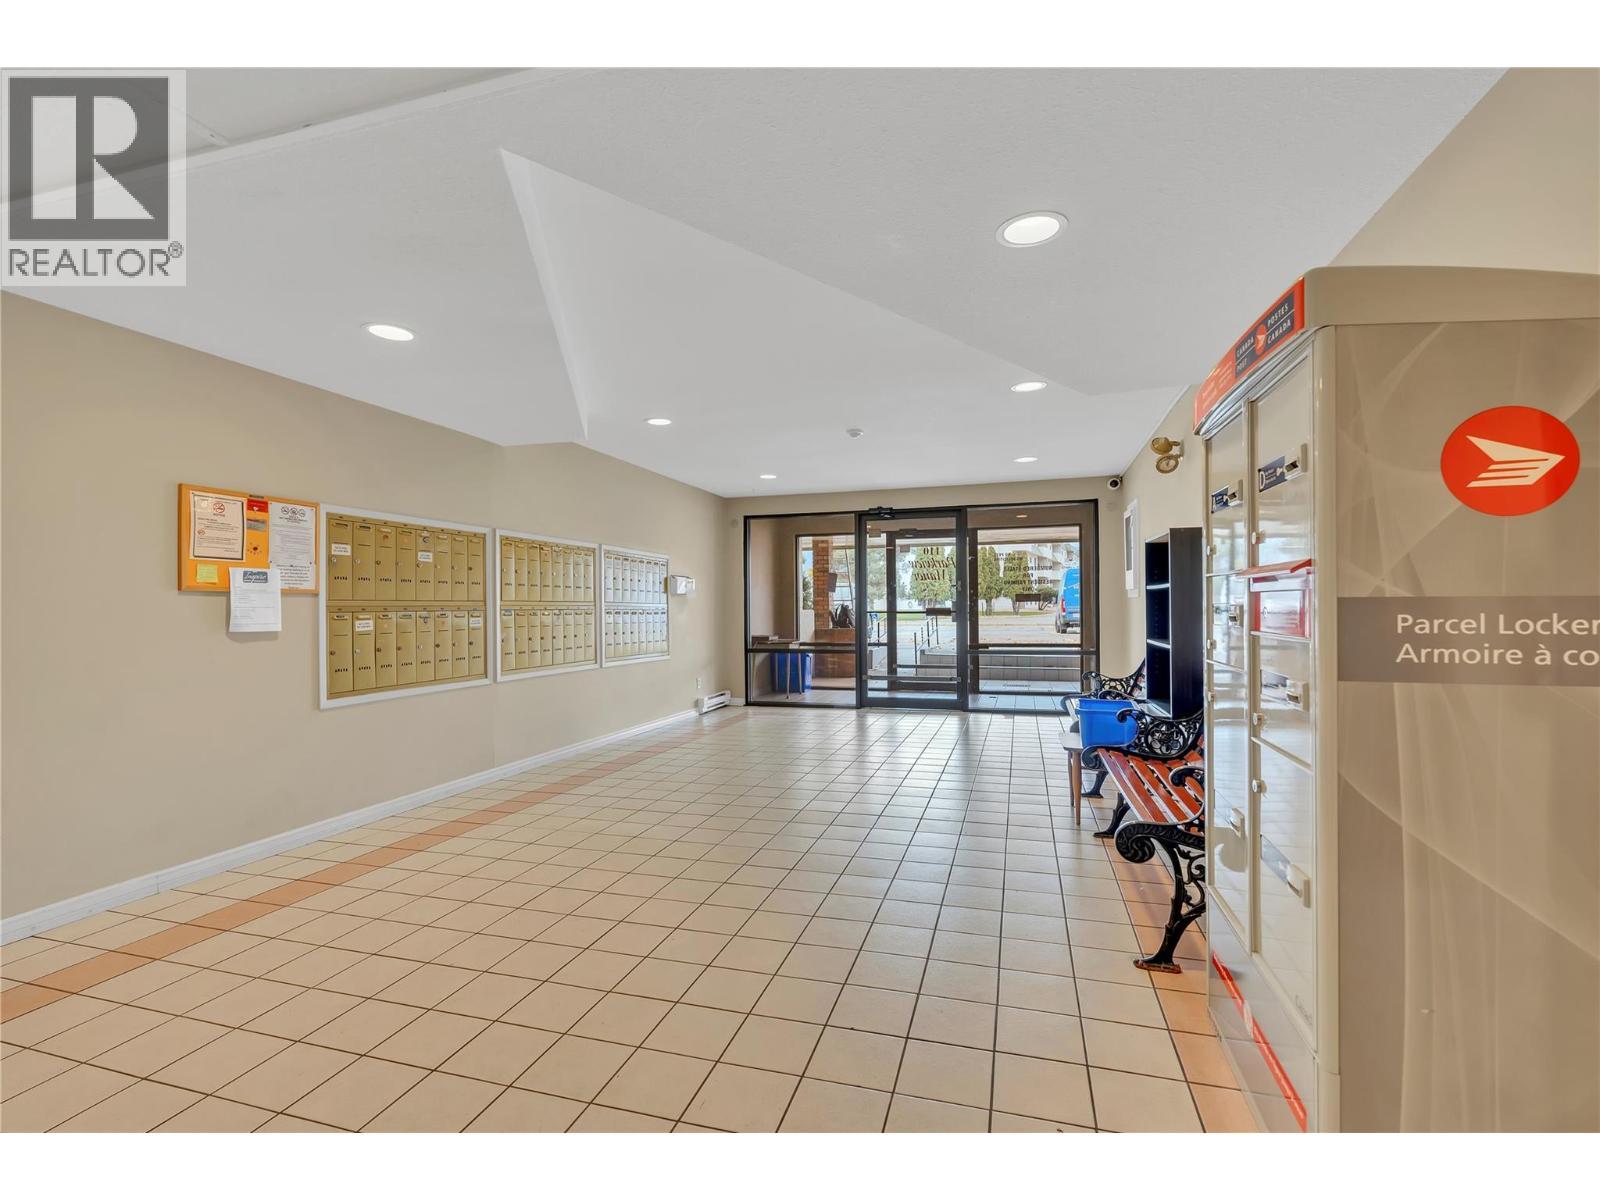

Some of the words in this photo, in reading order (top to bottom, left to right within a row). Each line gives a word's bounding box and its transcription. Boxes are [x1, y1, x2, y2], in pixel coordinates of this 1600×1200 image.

[1267, 303, 1289, 328] POSTES
[1267, 319, 1291, 345] CANADA
[1236, 336, 1254, 358] CANADA
[1259, 471, 1266, 490] D
[1396, 612, 1486, 634] Parcel
[1498, 612, 1600, 635] Locker
[1395, 643, 1524, 665] Armoire
[1534, 643, 1552, 666] à
